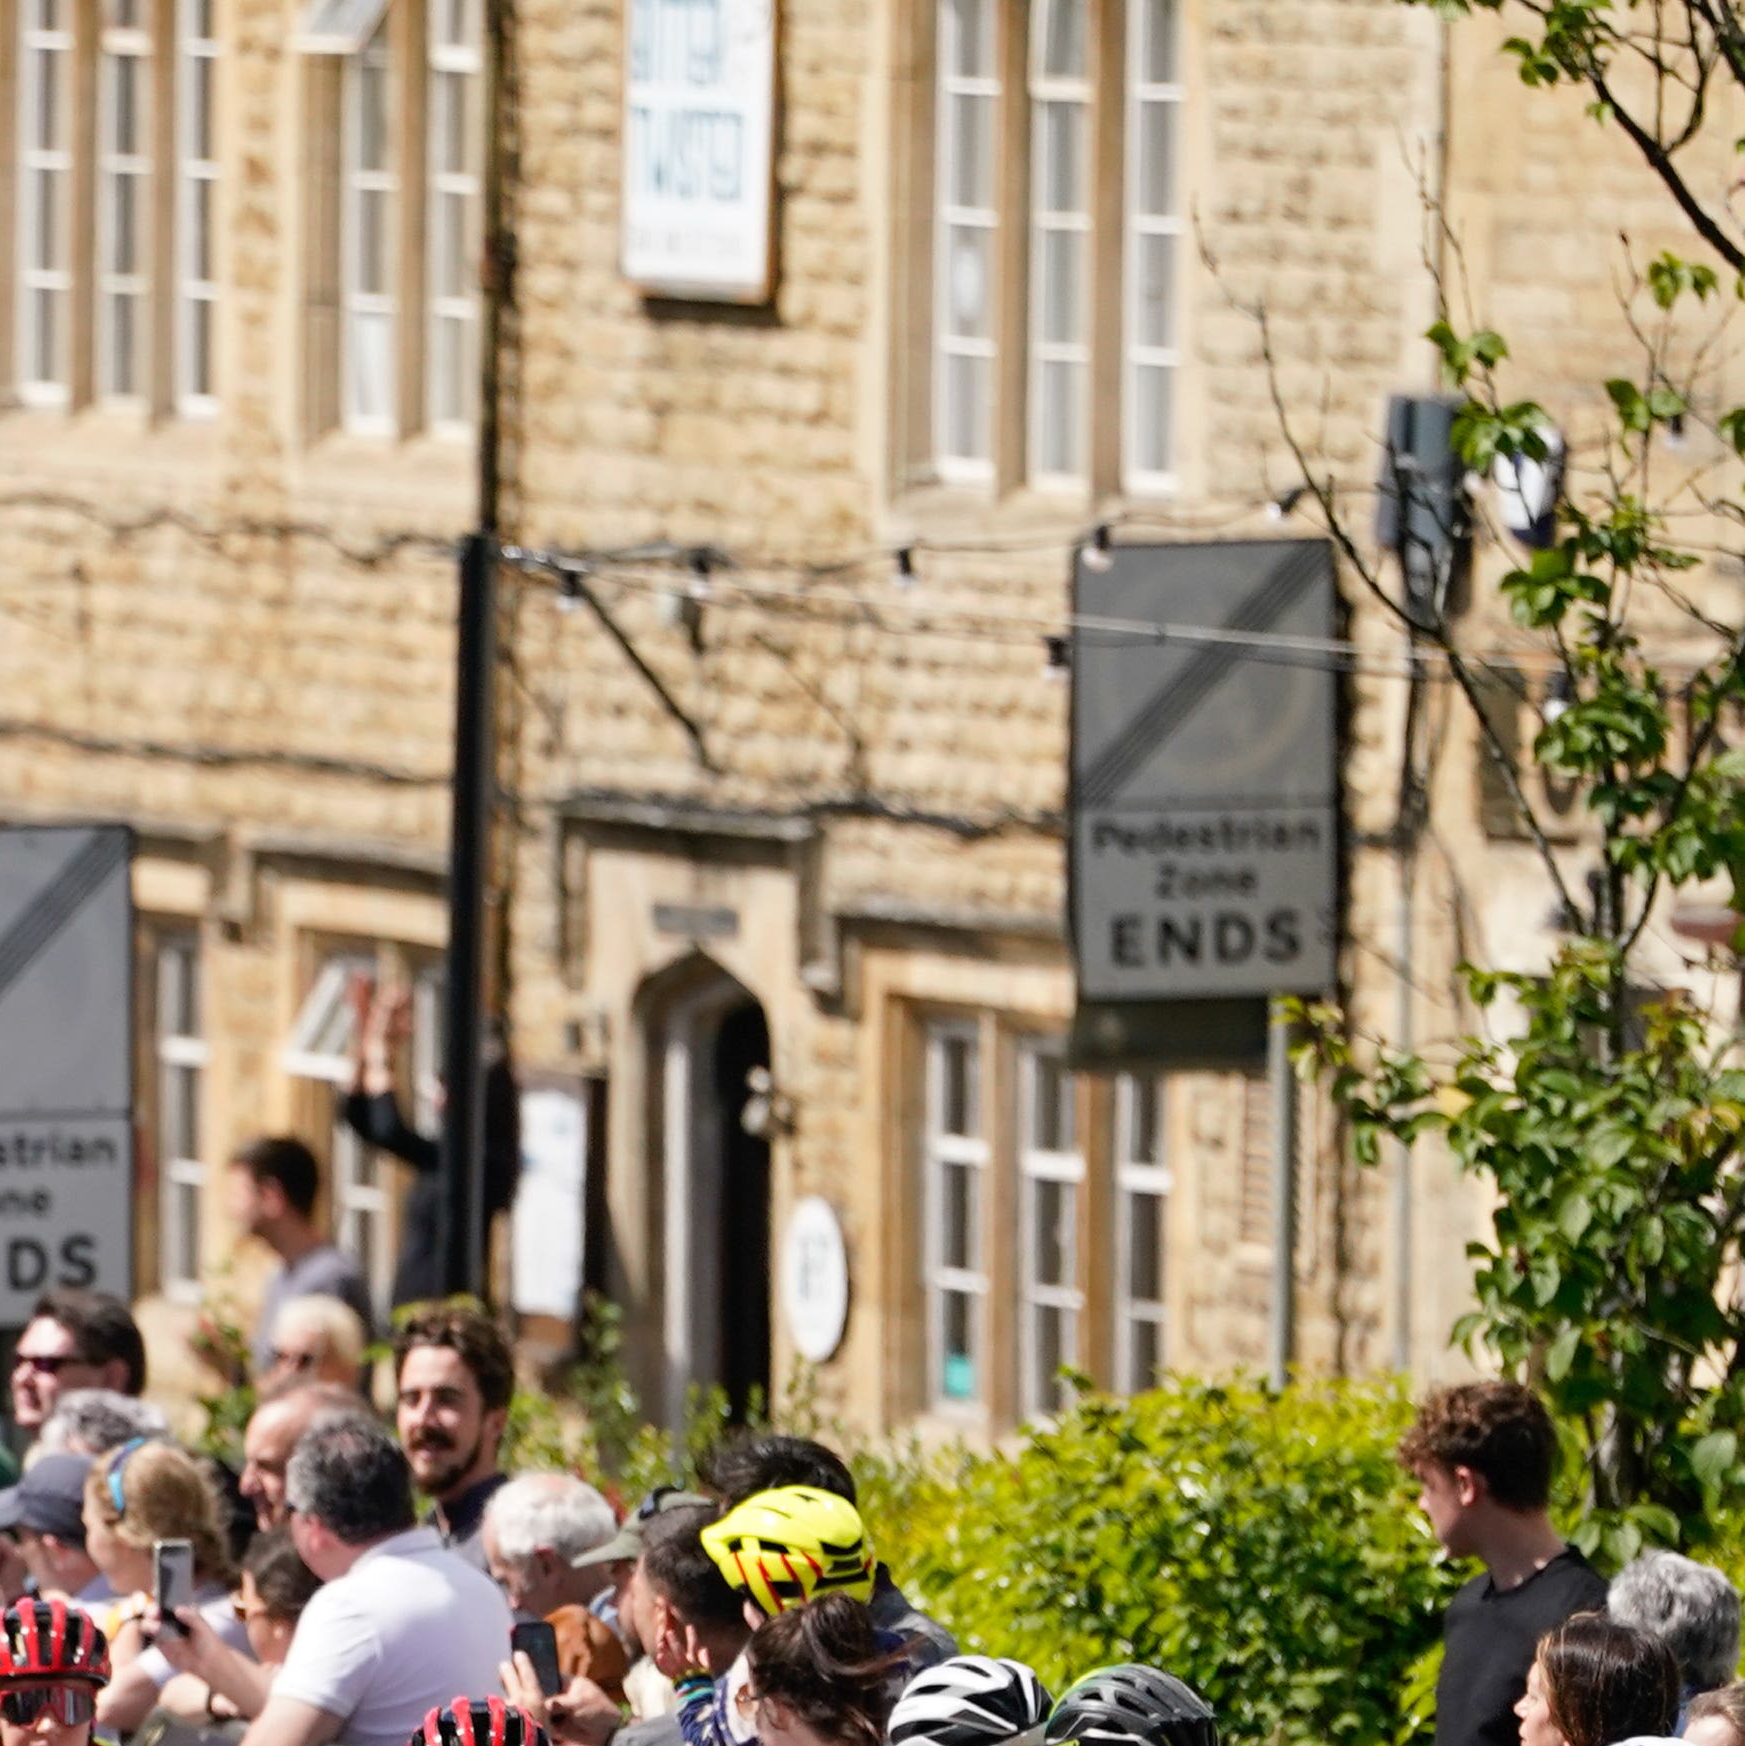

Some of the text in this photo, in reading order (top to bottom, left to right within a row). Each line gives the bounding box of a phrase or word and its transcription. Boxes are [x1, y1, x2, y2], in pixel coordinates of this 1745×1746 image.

[1089, 813, 1323, 861] Pedestrian
[1154, 863, 1259, 904] Zone
[1111, 911, 1304, 971] ENDS
